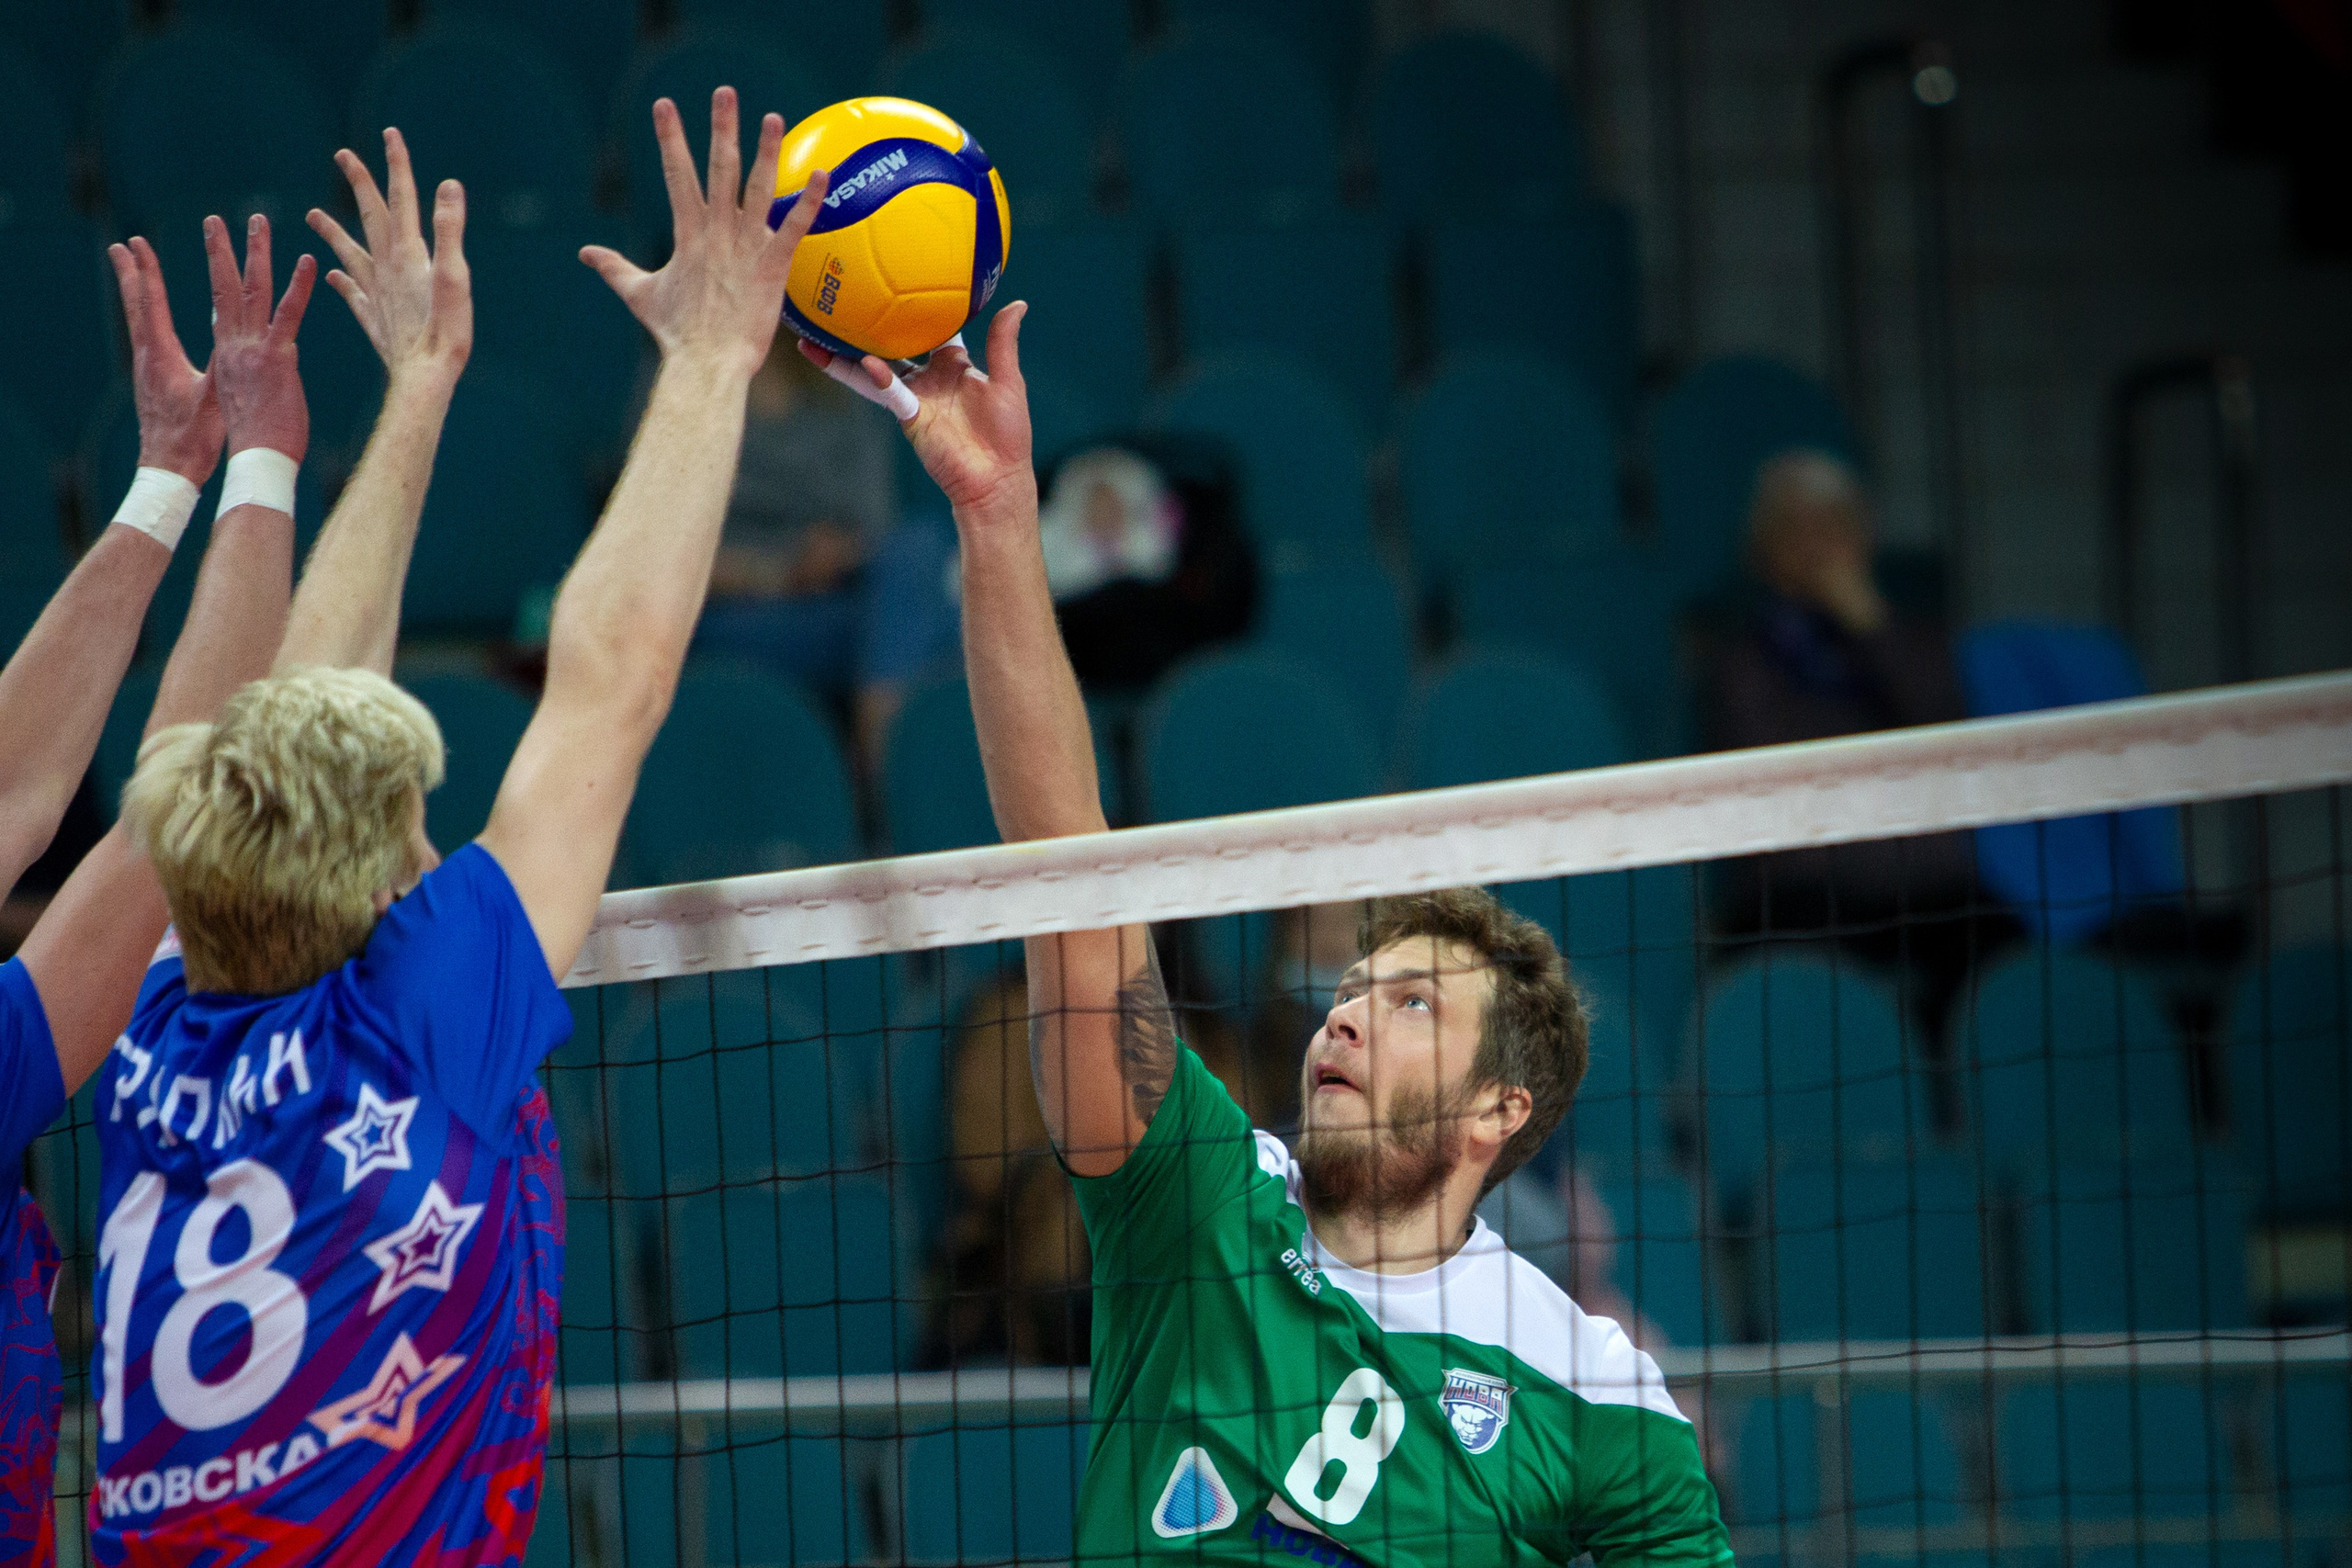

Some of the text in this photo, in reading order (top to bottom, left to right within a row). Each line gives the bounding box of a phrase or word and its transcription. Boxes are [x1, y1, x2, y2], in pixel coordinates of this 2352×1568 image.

[822, 148, 909, 209] MIKASA
[98, 1157, 309, 1443] 18
[97, 1419, 368, 1518] КОВСКА
[1283, 1367, 1406, 1526] 8
